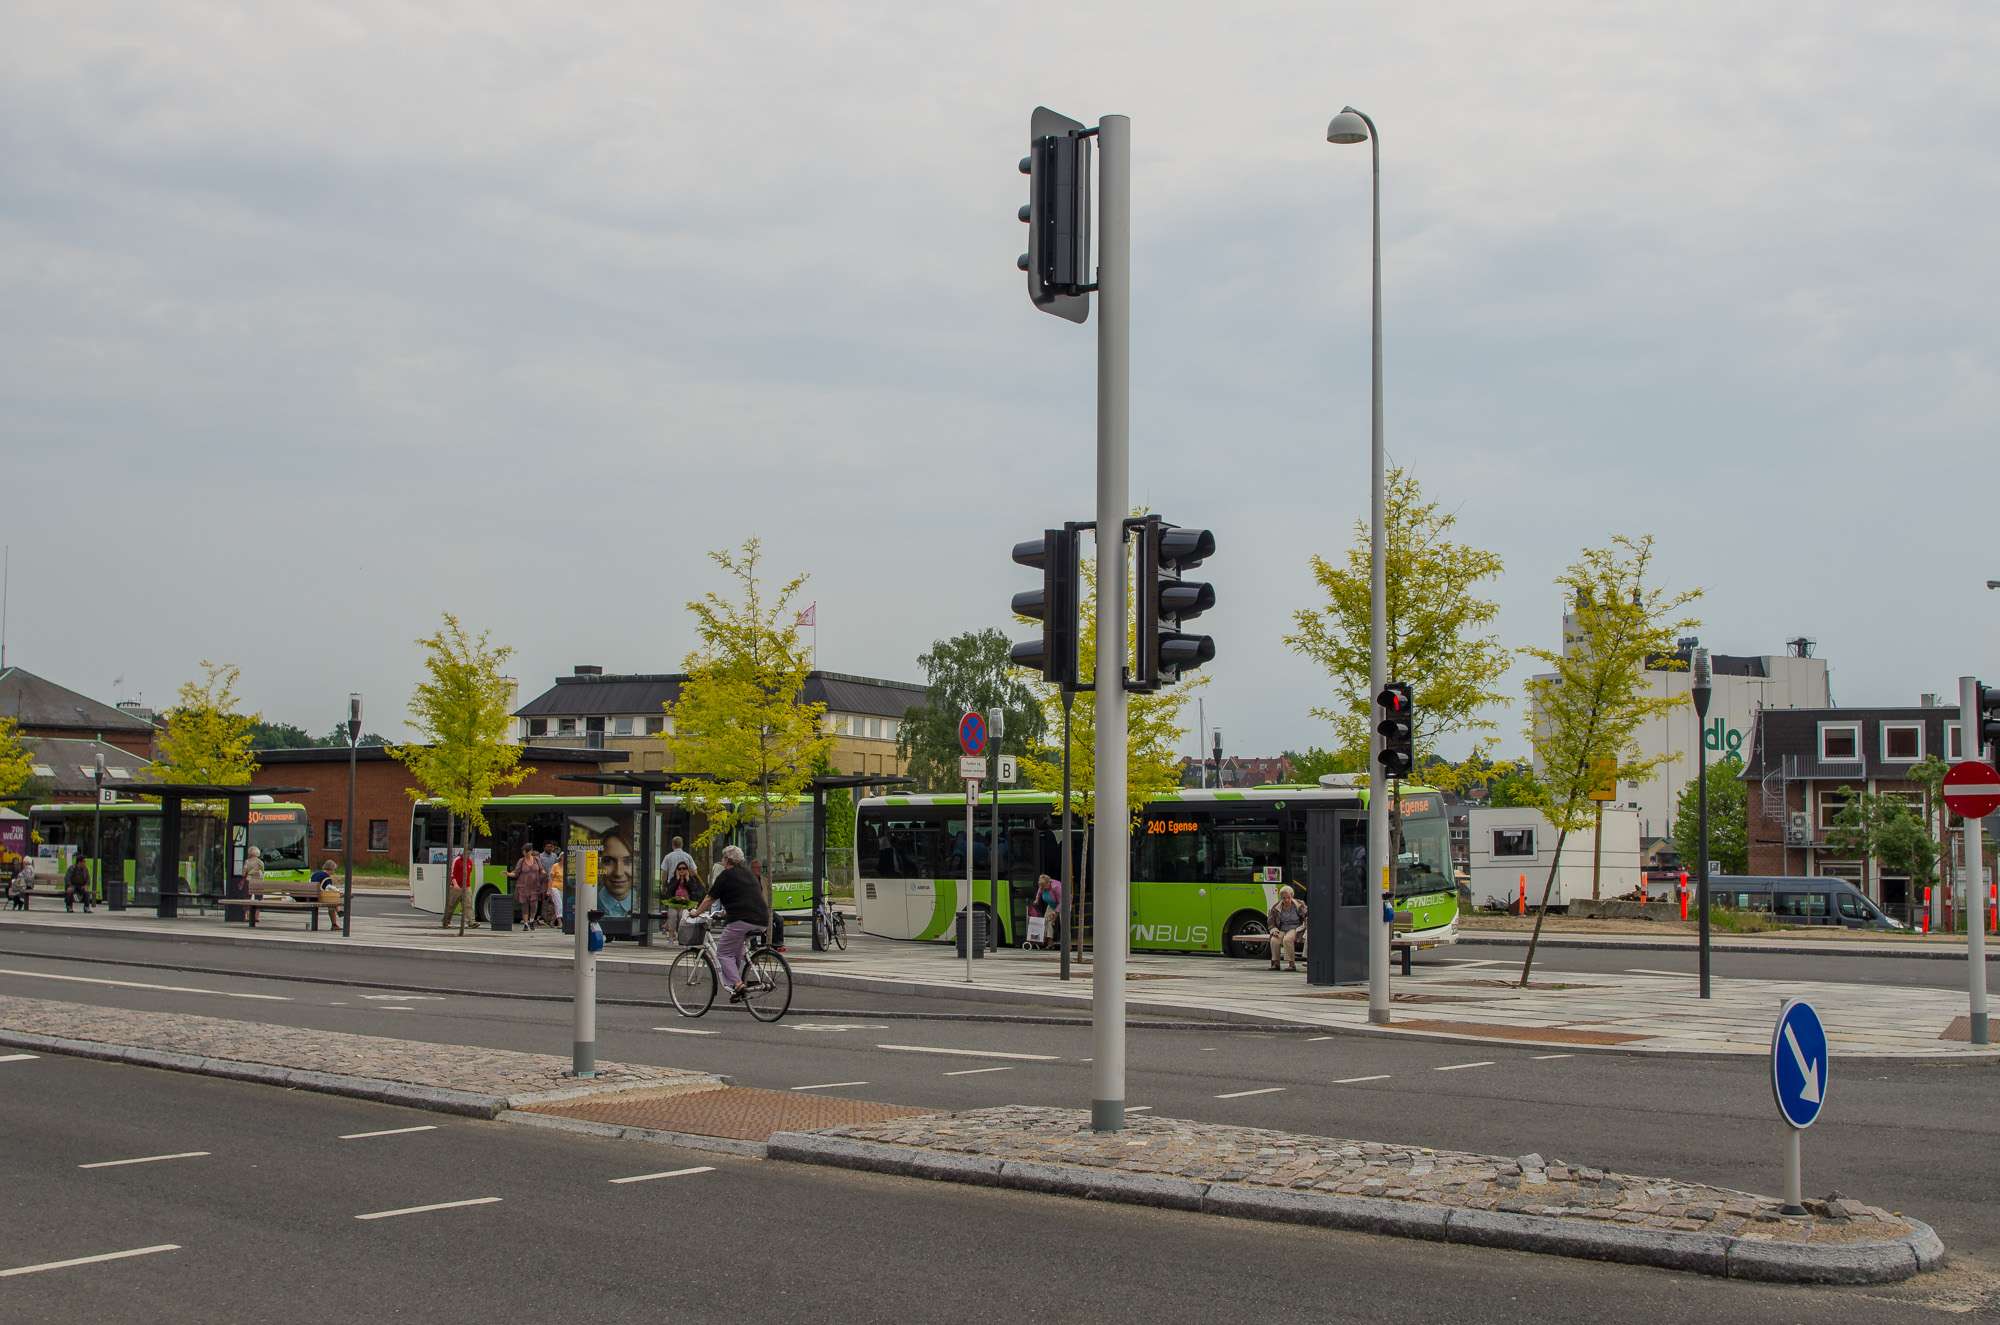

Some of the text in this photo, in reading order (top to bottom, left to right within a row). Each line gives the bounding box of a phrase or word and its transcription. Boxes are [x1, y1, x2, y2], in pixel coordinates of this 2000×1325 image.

[1003, 763, 1011, 779] B
[104, 790, 112, 801] B
[1147, 820, 1198, 834] 240 Egense
[2, 832, 24, 841] WEAR
[1407, 893, 1445, 908] FYNBUS
